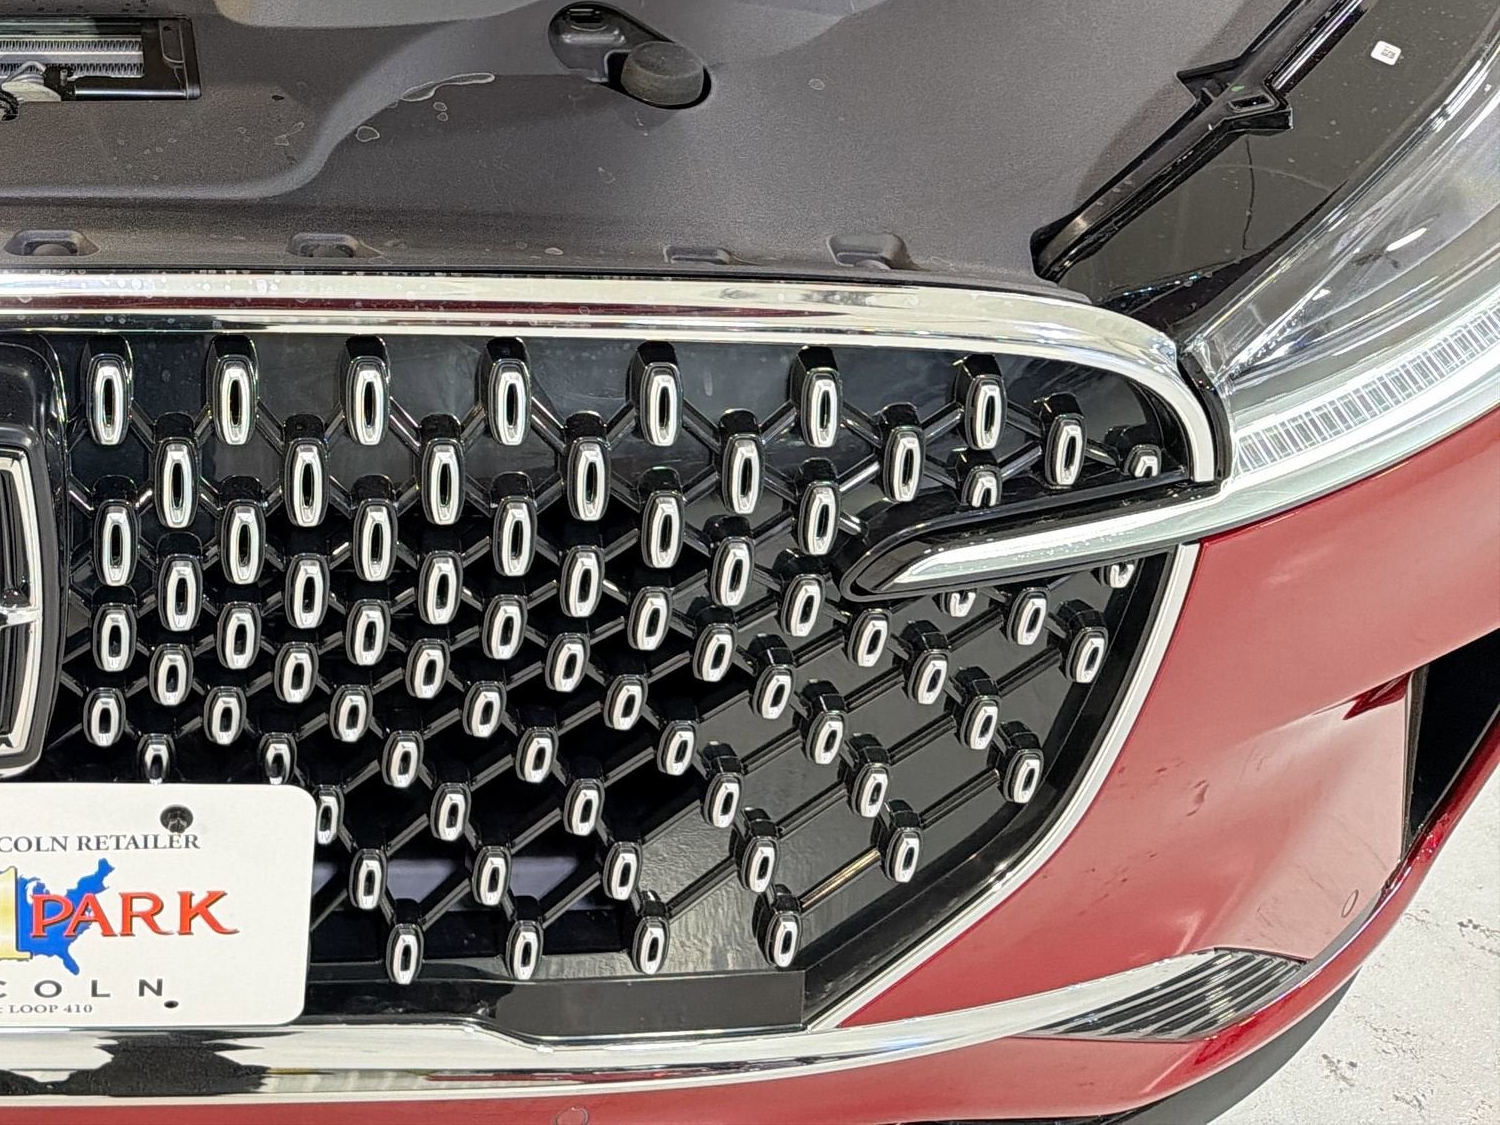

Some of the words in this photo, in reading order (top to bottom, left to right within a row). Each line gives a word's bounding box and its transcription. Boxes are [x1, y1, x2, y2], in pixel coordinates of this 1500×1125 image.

[76, 833, 201, 852] RETAILER
[30, 890, 241, 938] PARK
[8, 1004, 59, 1014] LOOP
[63, 1004, 93, 1014] 410
